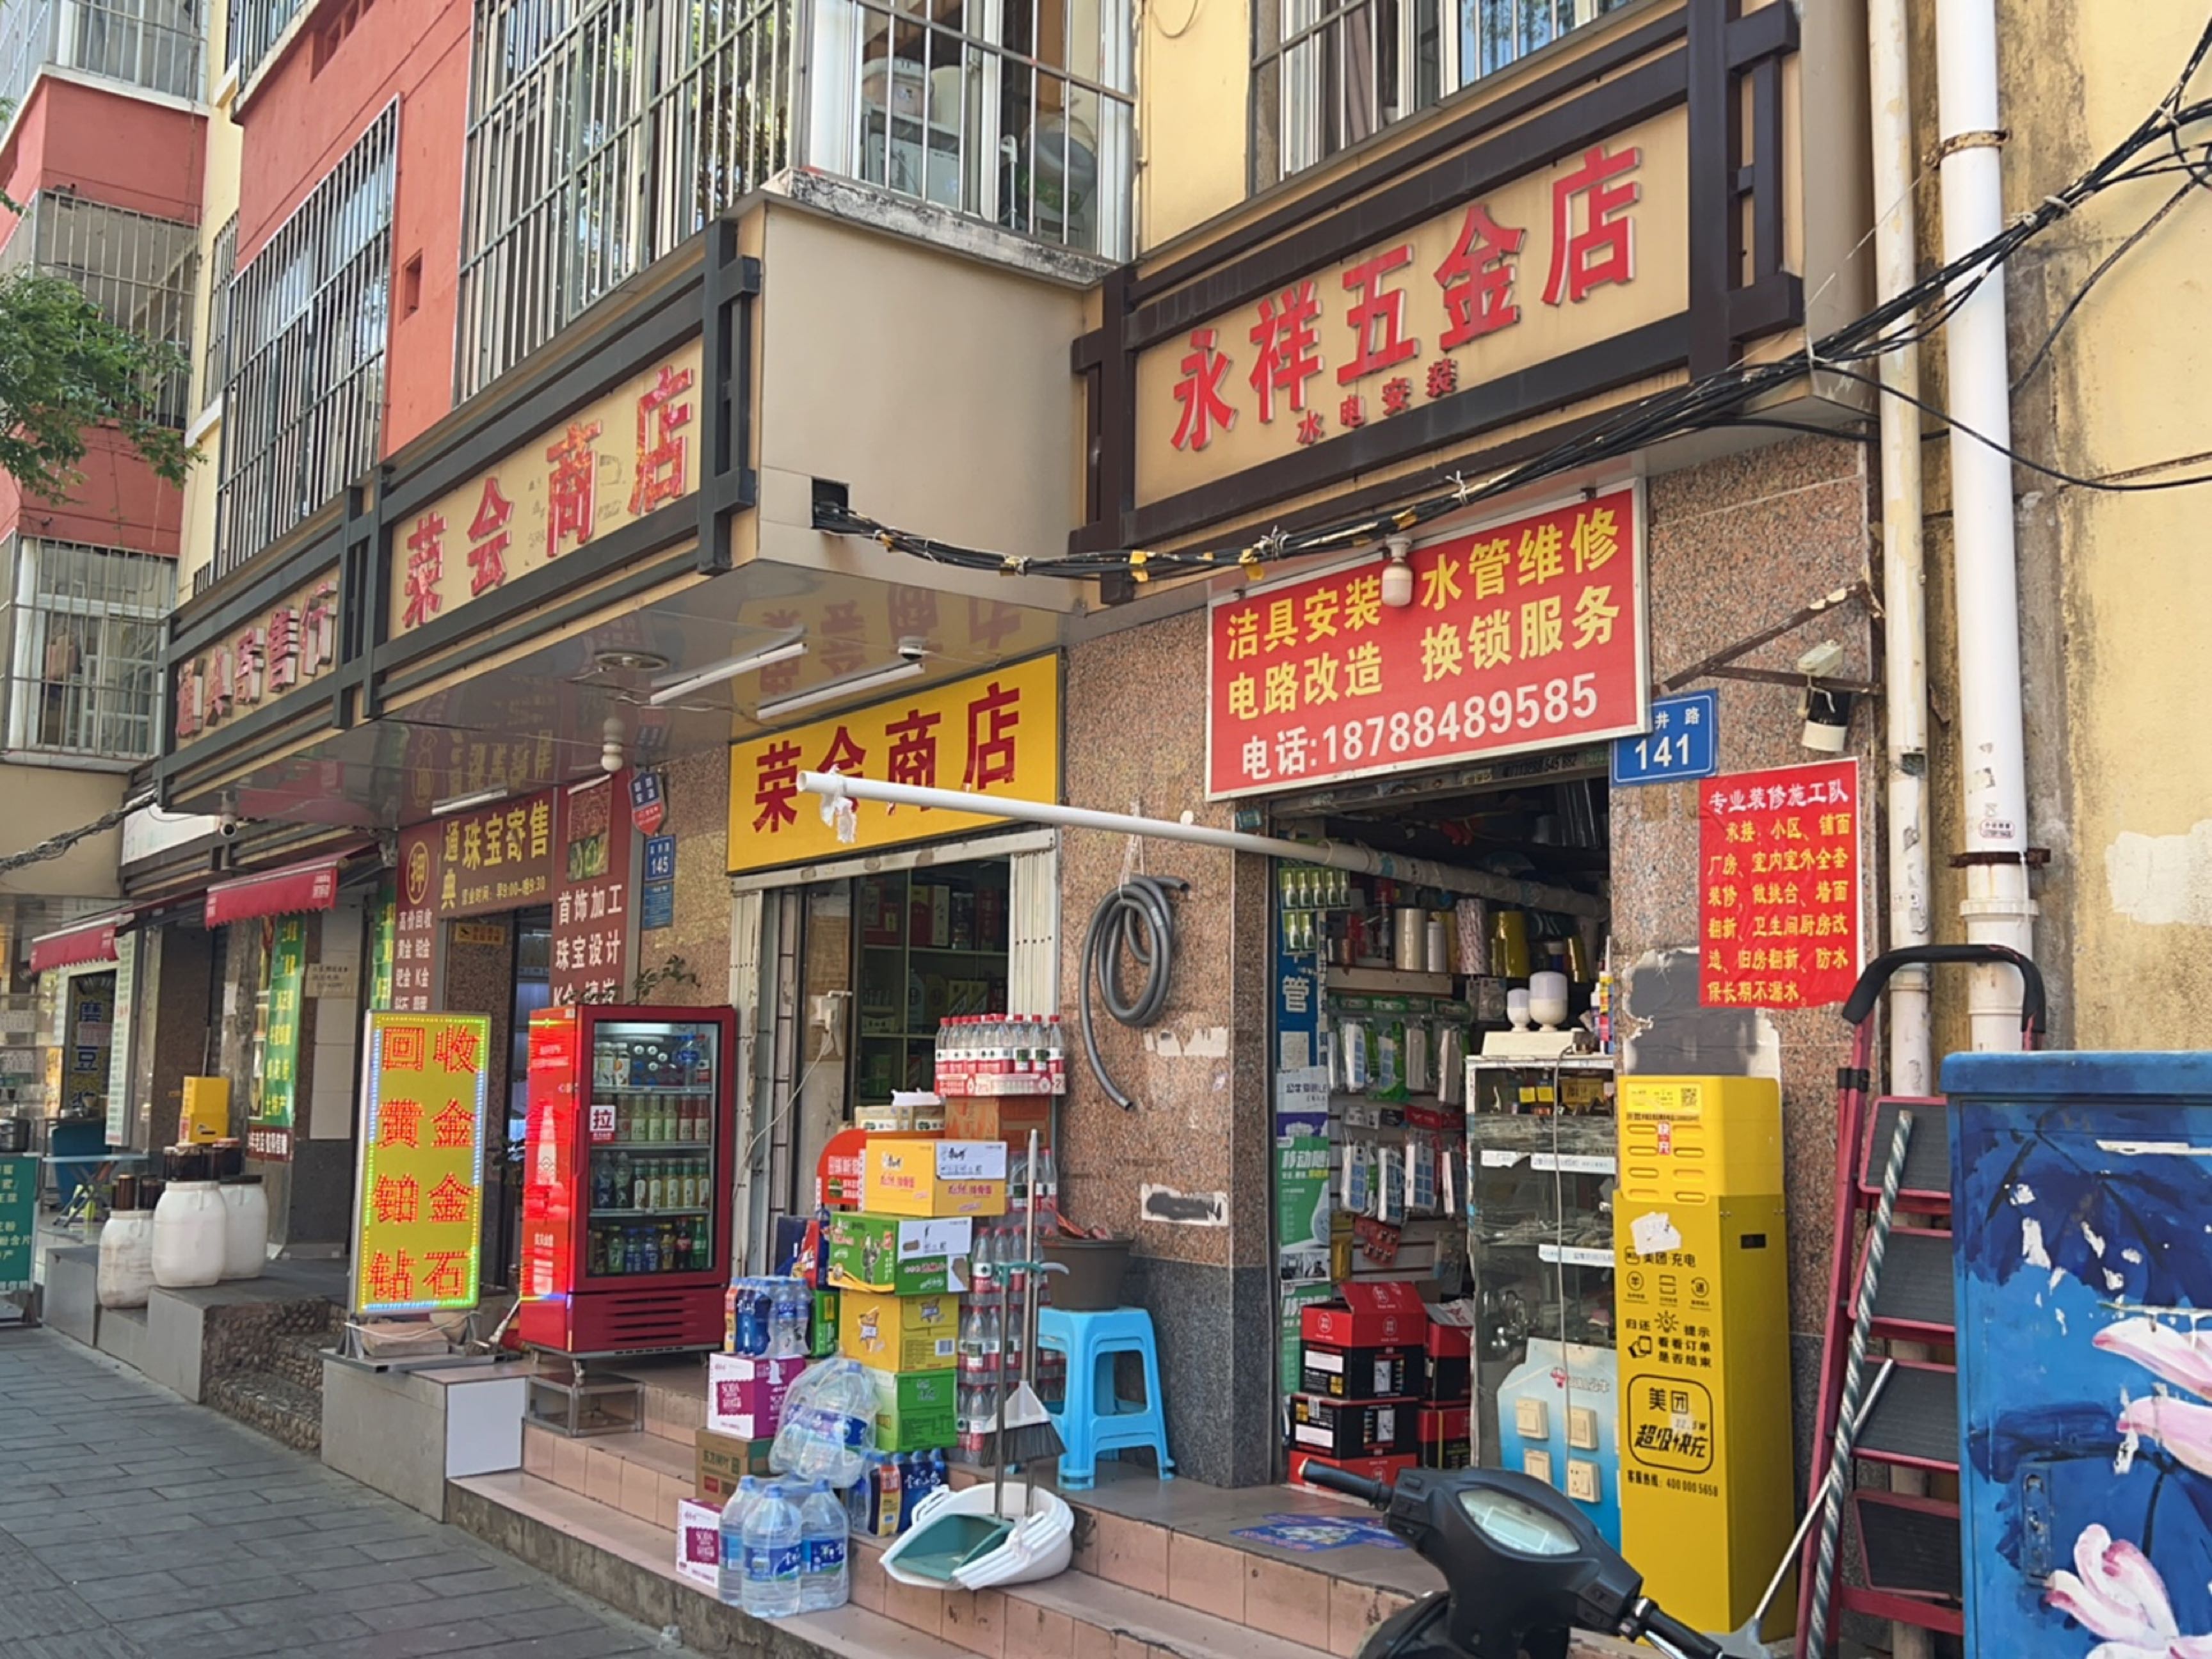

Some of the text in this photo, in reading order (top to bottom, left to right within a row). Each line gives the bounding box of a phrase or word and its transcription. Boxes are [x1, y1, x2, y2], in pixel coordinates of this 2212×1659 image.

[1171, 146, 1641, 452] 永祥五金店
[1296, 358, 1459, 445] 水电安装
[1227, 508, 1619, 661] 洁具安装 水管维修
[1228, 585, 1621, 721] 电路改造 换锁服务
[1635, 733, 1690, 770] 141
[1708, 778, 1848, 815] 专业装修施工队
[557, 884, 623, 926] 首饰加工
[555, 929, 621, 972] 珠宝设计
[1815, 946, 1848, 969] 防水
[381, 1025, 481, 1073] 回收
[378, 1098, 477, 1148] 黄金
[373, 1171, 473, 1224] 铂金
[369, 1246, 472, 1301] 钻石
[1658, 1351, 1712, 1368] 是否结束
[1649, 1387, 1688, 1414] 美团
